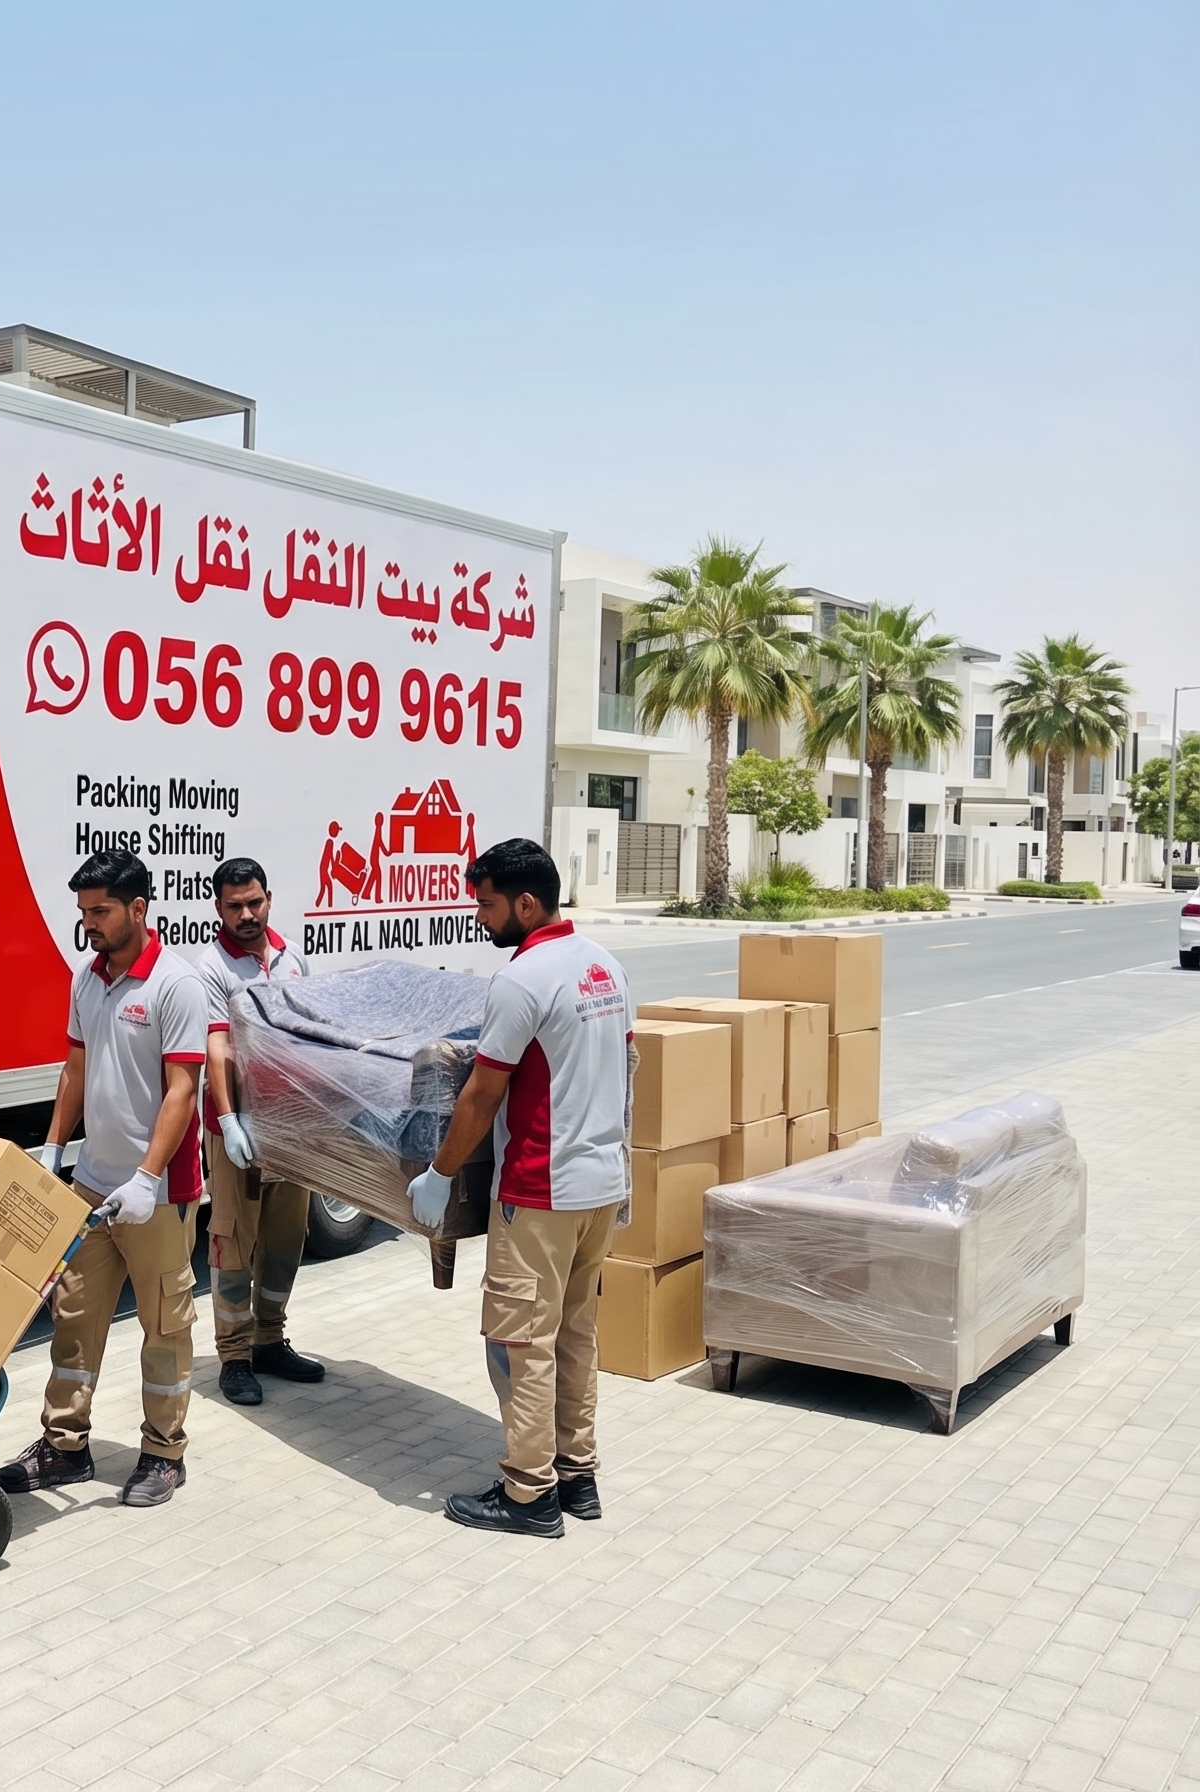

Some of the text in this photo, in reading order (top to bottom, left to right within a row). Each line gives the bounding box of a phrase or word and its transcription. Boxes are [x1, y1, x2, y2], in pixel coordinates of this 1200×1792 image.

[20, 471, 535, 652] شركة بيت النقل نقل الأثاث
[104, 630, 522, 749] 056 899 9615
[76, 774, 239, 818] Packing Moving
[76, 822, 225, 862] House Shifting
[389, 864, 460, 903] MOVERS
[304, 922, 346, 955] BAIT
[351, 920, 373, 952] AL
[379, 917, 423, 951] NAQL
